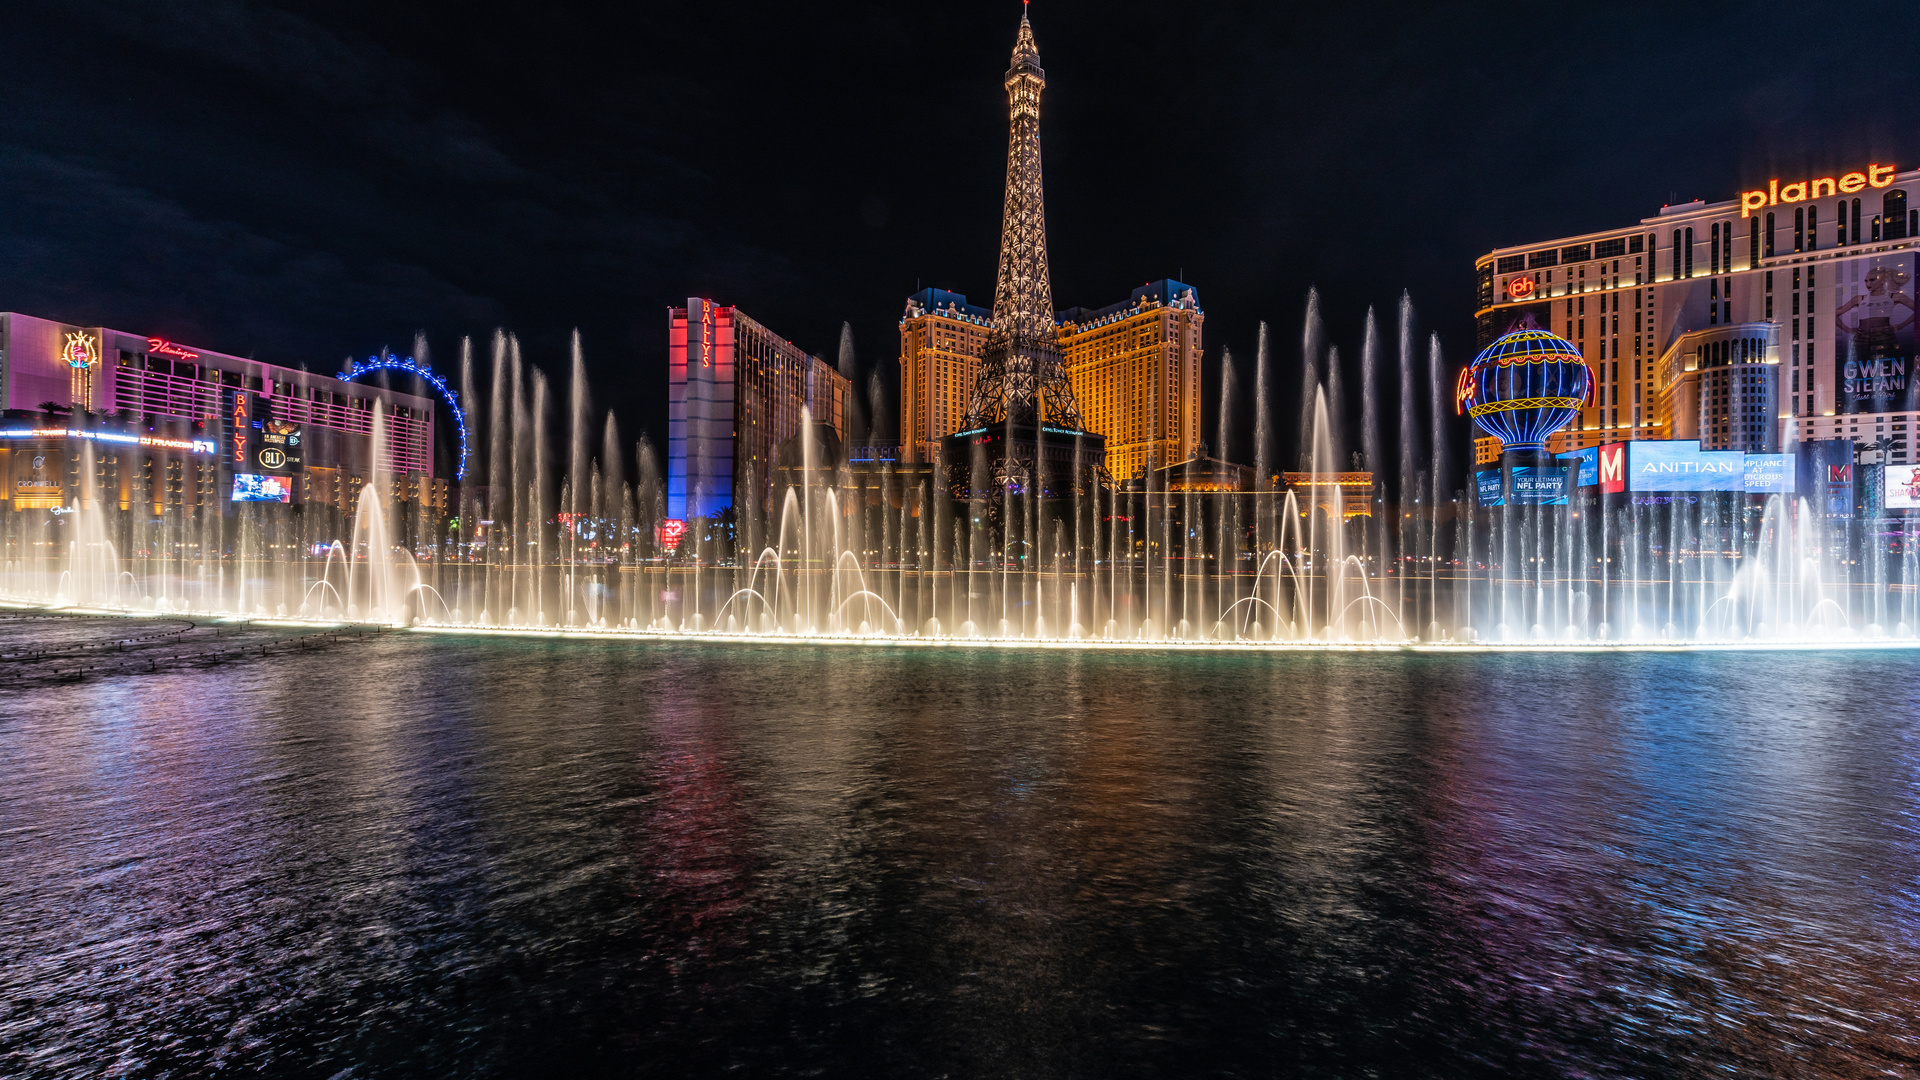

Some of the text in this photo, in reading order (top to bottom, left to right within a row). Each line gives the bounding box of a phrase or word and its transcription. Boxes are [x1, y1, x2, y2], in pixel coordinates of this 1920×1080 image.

[1741, 163, 1895, 218] planet
[1512, 277, 1534, 295] ph
[701, 300, 711, 368] BALLYS
[147, 338, 199, 360] Flamingo
[1843, 357, 1905, 379] GWEN
[1843, 375, 1905, 393] STEFANI
[233, 394, 247, 462] BALLYS
[265, 451, 281, 464] BLT
[1601, 447, 1622, 483] M
[1642, 461, 1733, 473] ANITIAN
[1517, 482, 1563, 490] NFL PARTY
[1744, 473, 1783, 481] DICROUS
[1744, 480, 1771, 488] SPEED
